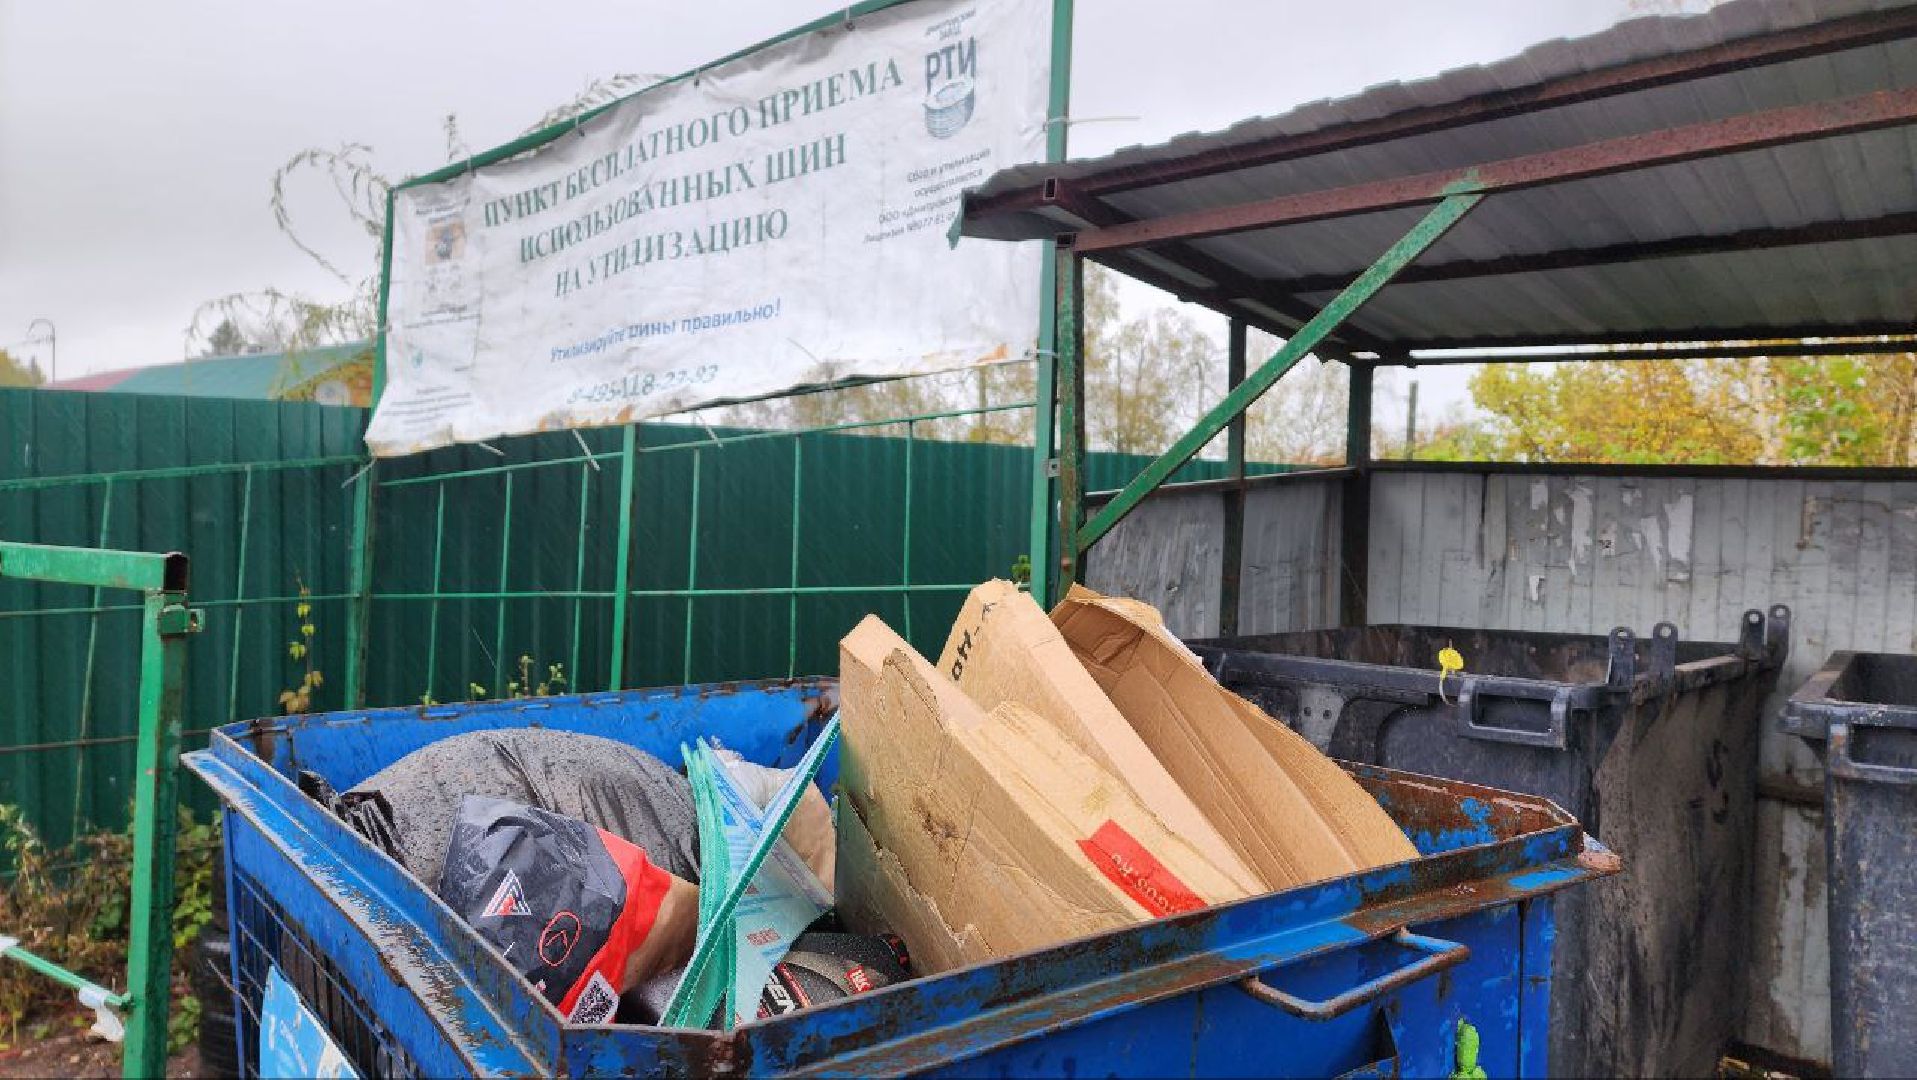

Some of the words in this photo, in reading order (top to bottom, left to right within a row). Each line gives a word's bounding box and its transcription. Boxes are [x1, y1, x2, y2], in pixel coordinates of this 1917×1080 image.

[925, 35, 976, 96] РТИ
[484, 180, 562, 228] ПУНКТ
[566, 105, 750, 201] БЕСПЛАТНОГО
[758, 57, 904, 128] ПРИЕМА
[520, 159, 757, 264] ИСПОЛЬЗОВАННЫХ
[766, 133, 848, 185] ШИН
[554, 266, 583, 299] НА
[587, 208, 789, 286] УТИЛИЗАЦИЮ
[681, 297, 782, 335] правильно!
